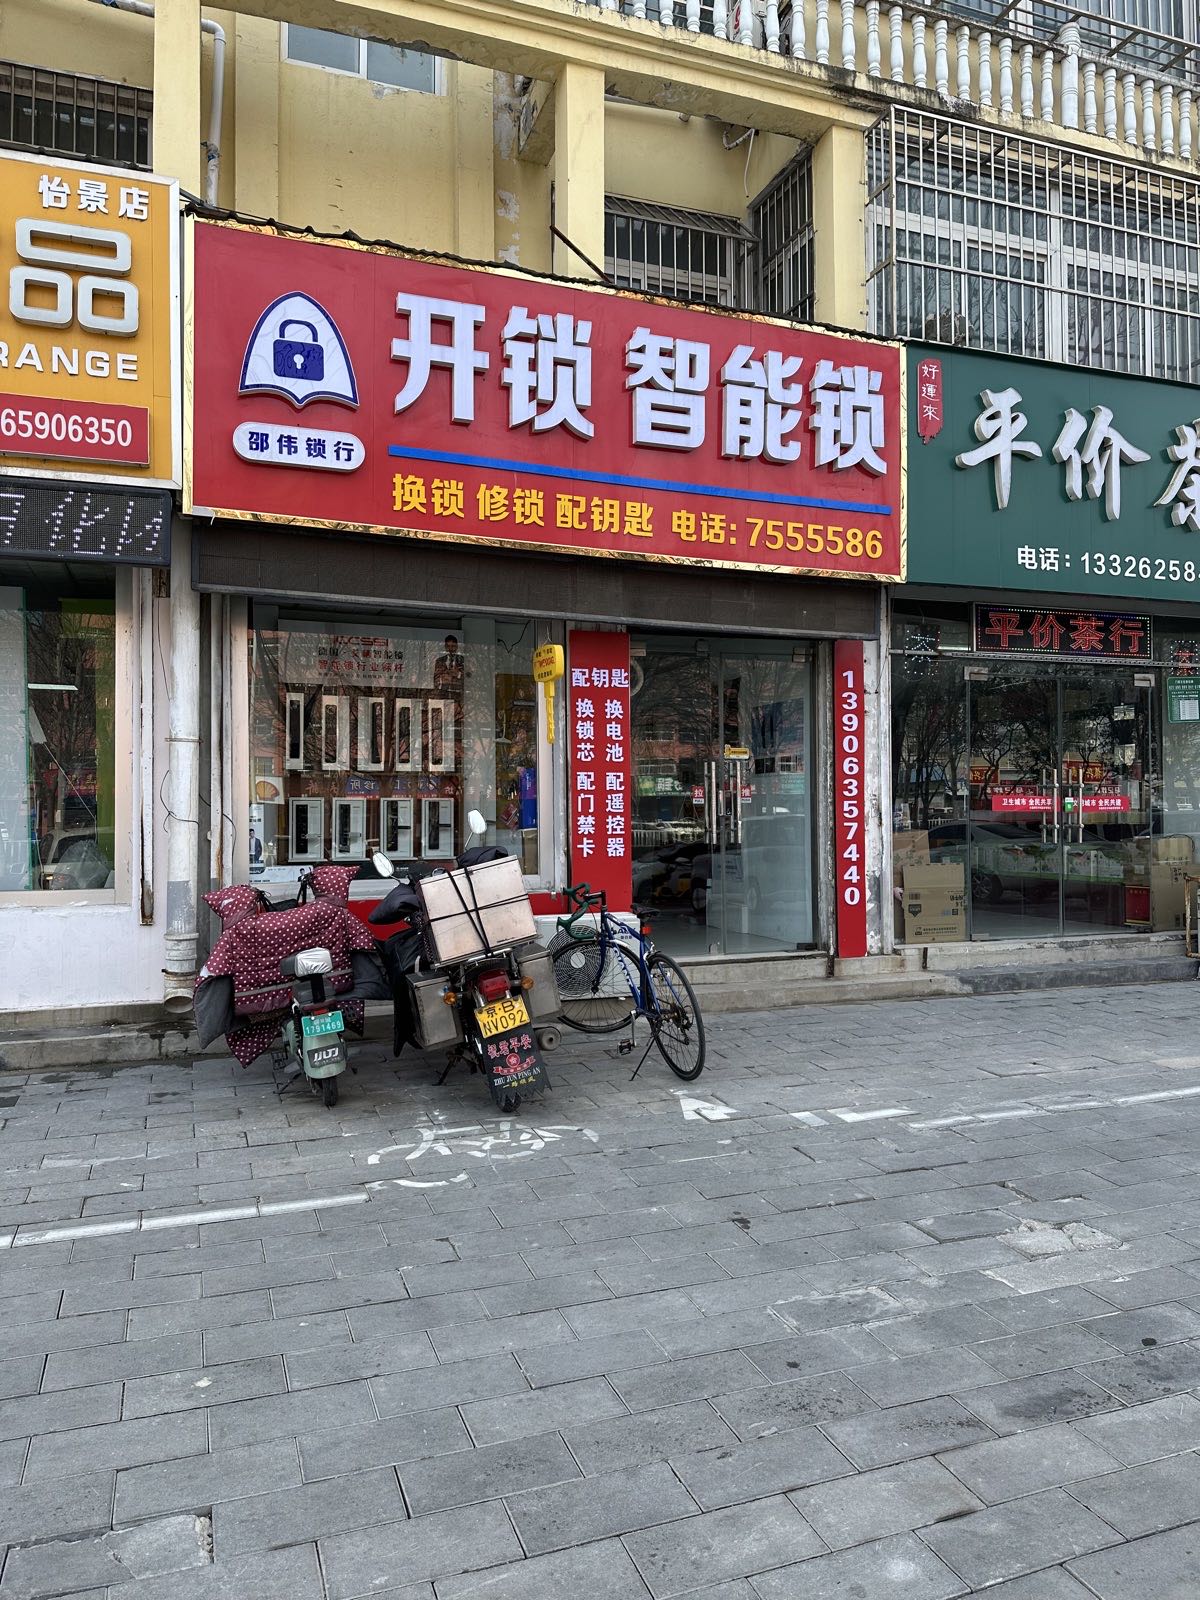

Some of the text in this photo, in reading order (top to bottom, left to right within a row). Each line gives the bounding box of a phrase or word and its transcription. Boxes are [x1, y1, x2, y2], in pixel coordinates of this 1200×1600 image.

[38, 174, 150, 221] 怡景店
[390, 291, 888, 476] 开锁 智能锁
[921, 364, 940, 421] 好運來
[0, 408, 132, 447] 65906350
[248, 431, 354, 462] 邵伟锁行
[392, 474, 465, 519] 换锁
[477, 483, 545, 527] 修锁
[556, 493, 654, 539] 配钥匙
[1017, 545, 1200, 582] 电话：13326258
[985, 611, 1144, 653] 平价茶行
[572, 667, 629, 688] 配钥匙
[576, 698, 596, 858] 换锁芯 配门禁卡
[605, 699, 625, 857] 换电池 配遥控器
[694, 788, 704, 798] 拉
[842, 670, 861, 906] 13906357440
[1002, 798, 1027, 806] 卫生城市
[306, 1020, 341, 1034] 1791469
[482, 1010, 526, 1035] NV092
[532, 1066, 541, 1075] AN
